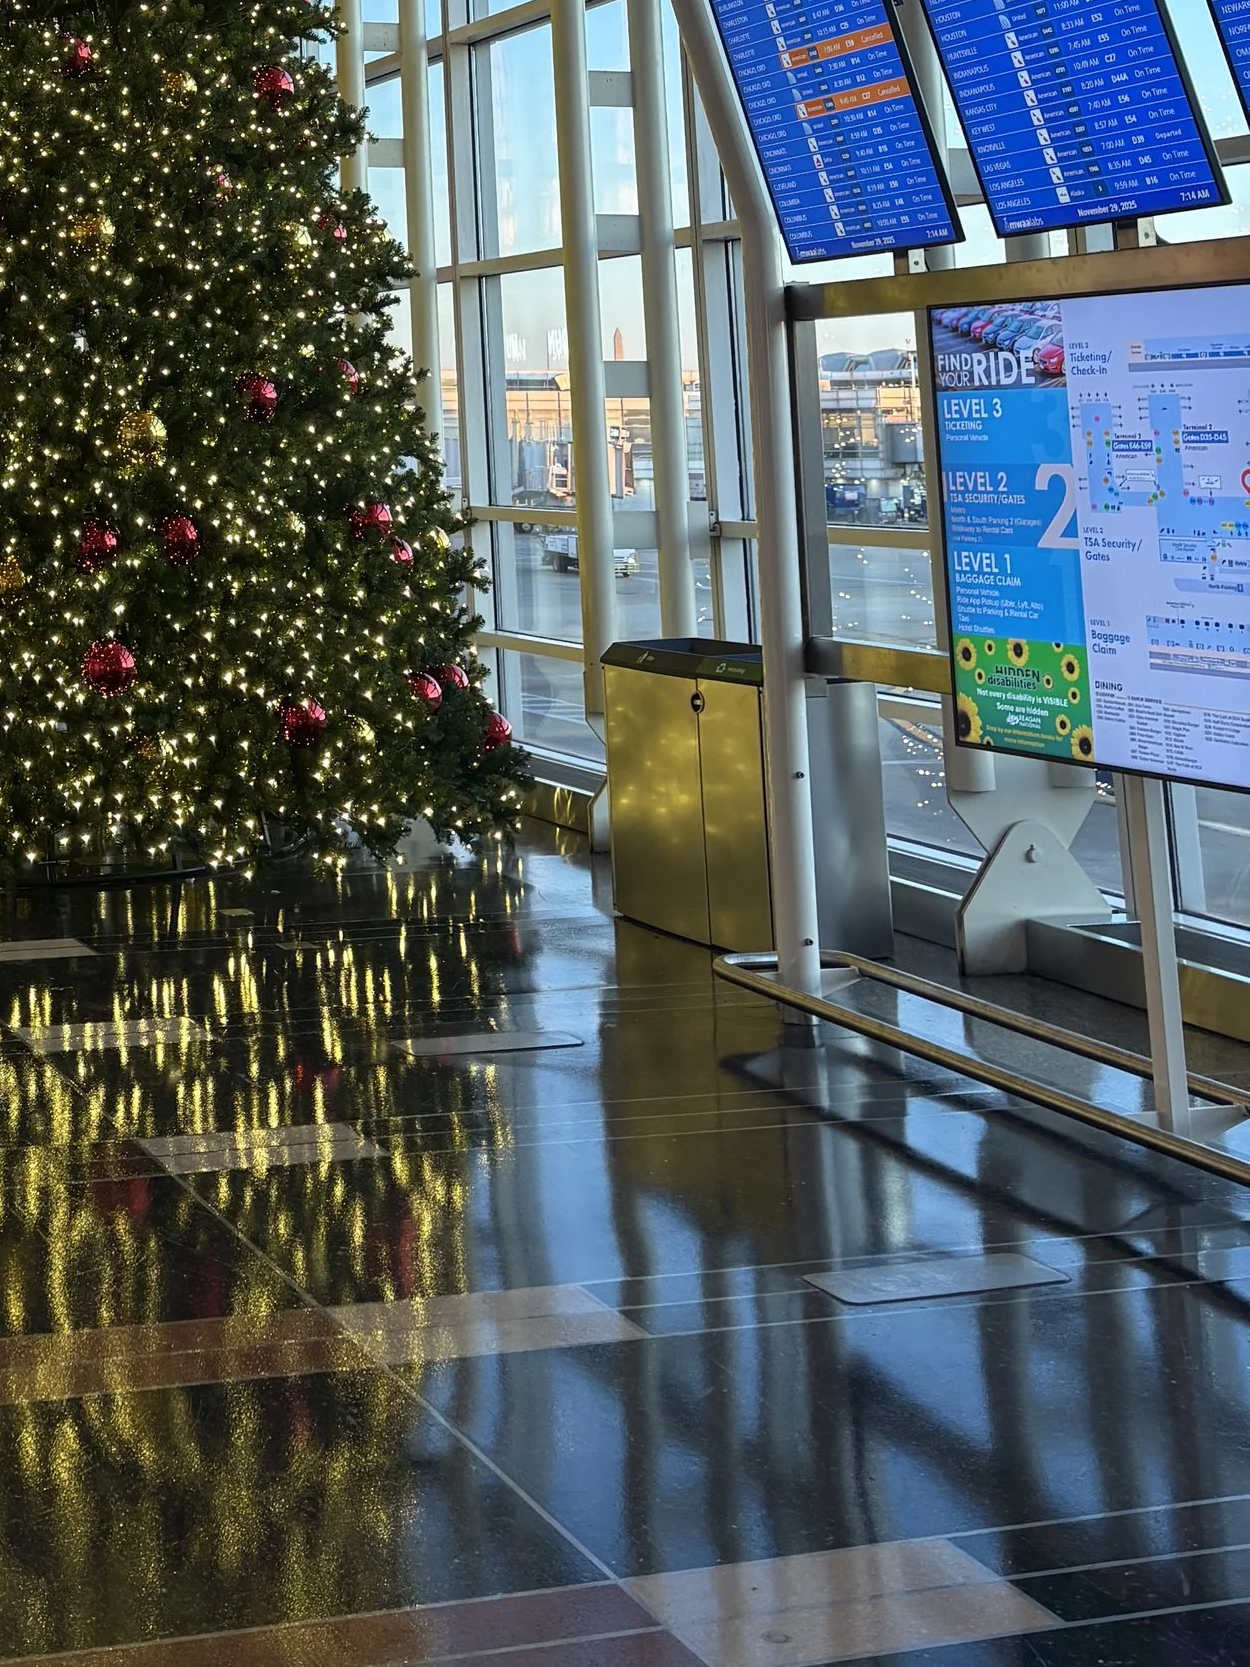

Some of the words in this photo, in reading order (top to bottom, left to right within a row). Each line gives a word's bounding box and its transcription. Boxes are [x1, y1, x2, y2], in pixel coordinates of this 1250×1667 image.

[1111, 138, 1124, 147] AM
[1130, 134, 1145, 144] D39
[1154, 126, 1182, 139] Departed
[1077, 204, 1110, 217] November
[1108, 202, 1121, 213] 29,
[1120, 200, 1137, 210] 2025
[1179, 190, 1196, 201] 7:14
[1194, 188, 1210, 199] AM
[1070, 351, 1112, 362] Ticketing/
[938, 354, 970, 371] FIND
[972, 351, 1035, 386] RIDE
[1071, 366, 1107, 375] Check-In
[939, 372, 970, 387] YOUR
[943, 399, 988, 418] LEVEL
[993, 398, 1002, 418] 3
[945, 421, 982, 430] TICKETING
[949, 471, 993, 491] LEVEL
[997, 472, 1007, 491] 2
[950, 493, 963, 502] TSA
[965, 494, 1025, 504] SECURITY/GATES
[1035, 464, 1079, 549] 2
[1084, 537, 1099, 546] TSA
[1102, 539, 1142, 552] Security/
[954, 551, 999, 573] LEVEL
[1004, 554, 1011, 573] 1
[1085, 551, 1110, 561] Gates
[956, 573, 994, 584] BAGGAGE
[997, 576, 1021, 586] CLAIM
[1092, 630, 1130, 644] Baggage
[1092, 643, 1117, 655] Claim
[988, 676, 1036, 689] disabilities
[1095, 681, 1122, 691] DINING
[977, 688, 988, 696] Not
[990, 690, 1006, 700] every
[1007, 693, 1035, 704] disability
[1043, 697, 1068, 707] VISIBLE
[996, 702, 1014, 711] Some
[1026, 706, 1048, 716] hidden
